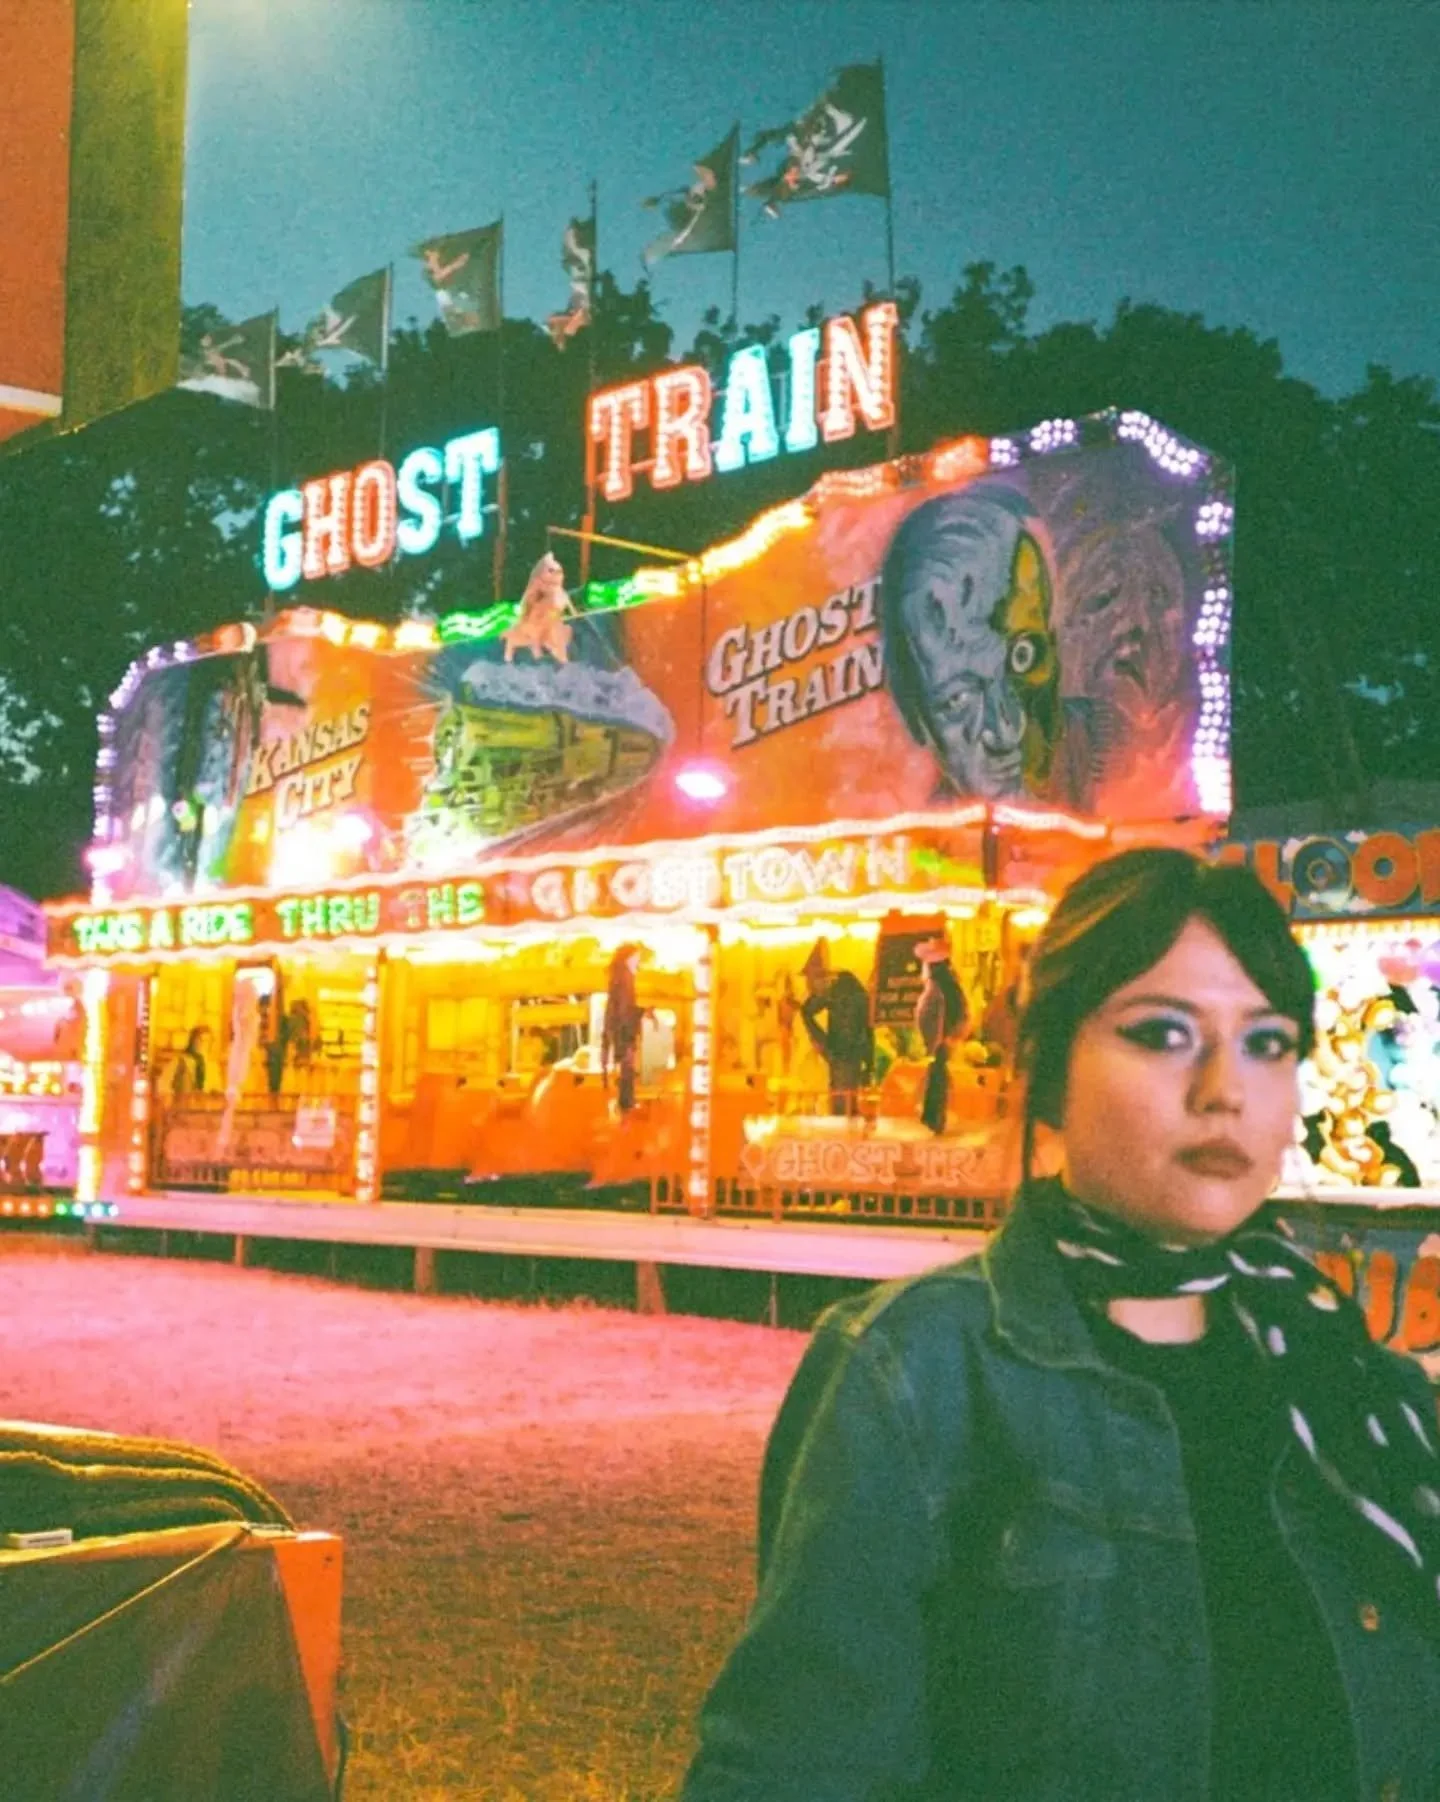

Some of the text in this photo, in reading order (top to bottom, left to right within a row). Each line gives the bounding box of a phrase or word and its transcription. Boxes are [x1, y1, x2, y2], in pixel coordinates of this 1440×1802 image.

[263, 301, 897, 590] GHOST TRAIN
[705, 574, 883, 697] GHOST
[725, 639, 885, 751] TRAIN
[244, 702, 372, 798] KANSAS
[273, 752, 365, 832] CITY
[74, 911, 144, 954] TAKE
[148, 909, 176, 949] A
[179, 903, 254, 945] RIDE
[275, 891, 380, 938] THRU
[401, 881, 486, 929] THE
[727, 835, 913, 900] TOWN
[1216, 827, 1440, 914] LOO
[774, 1139, 901, 1185] GHOST
